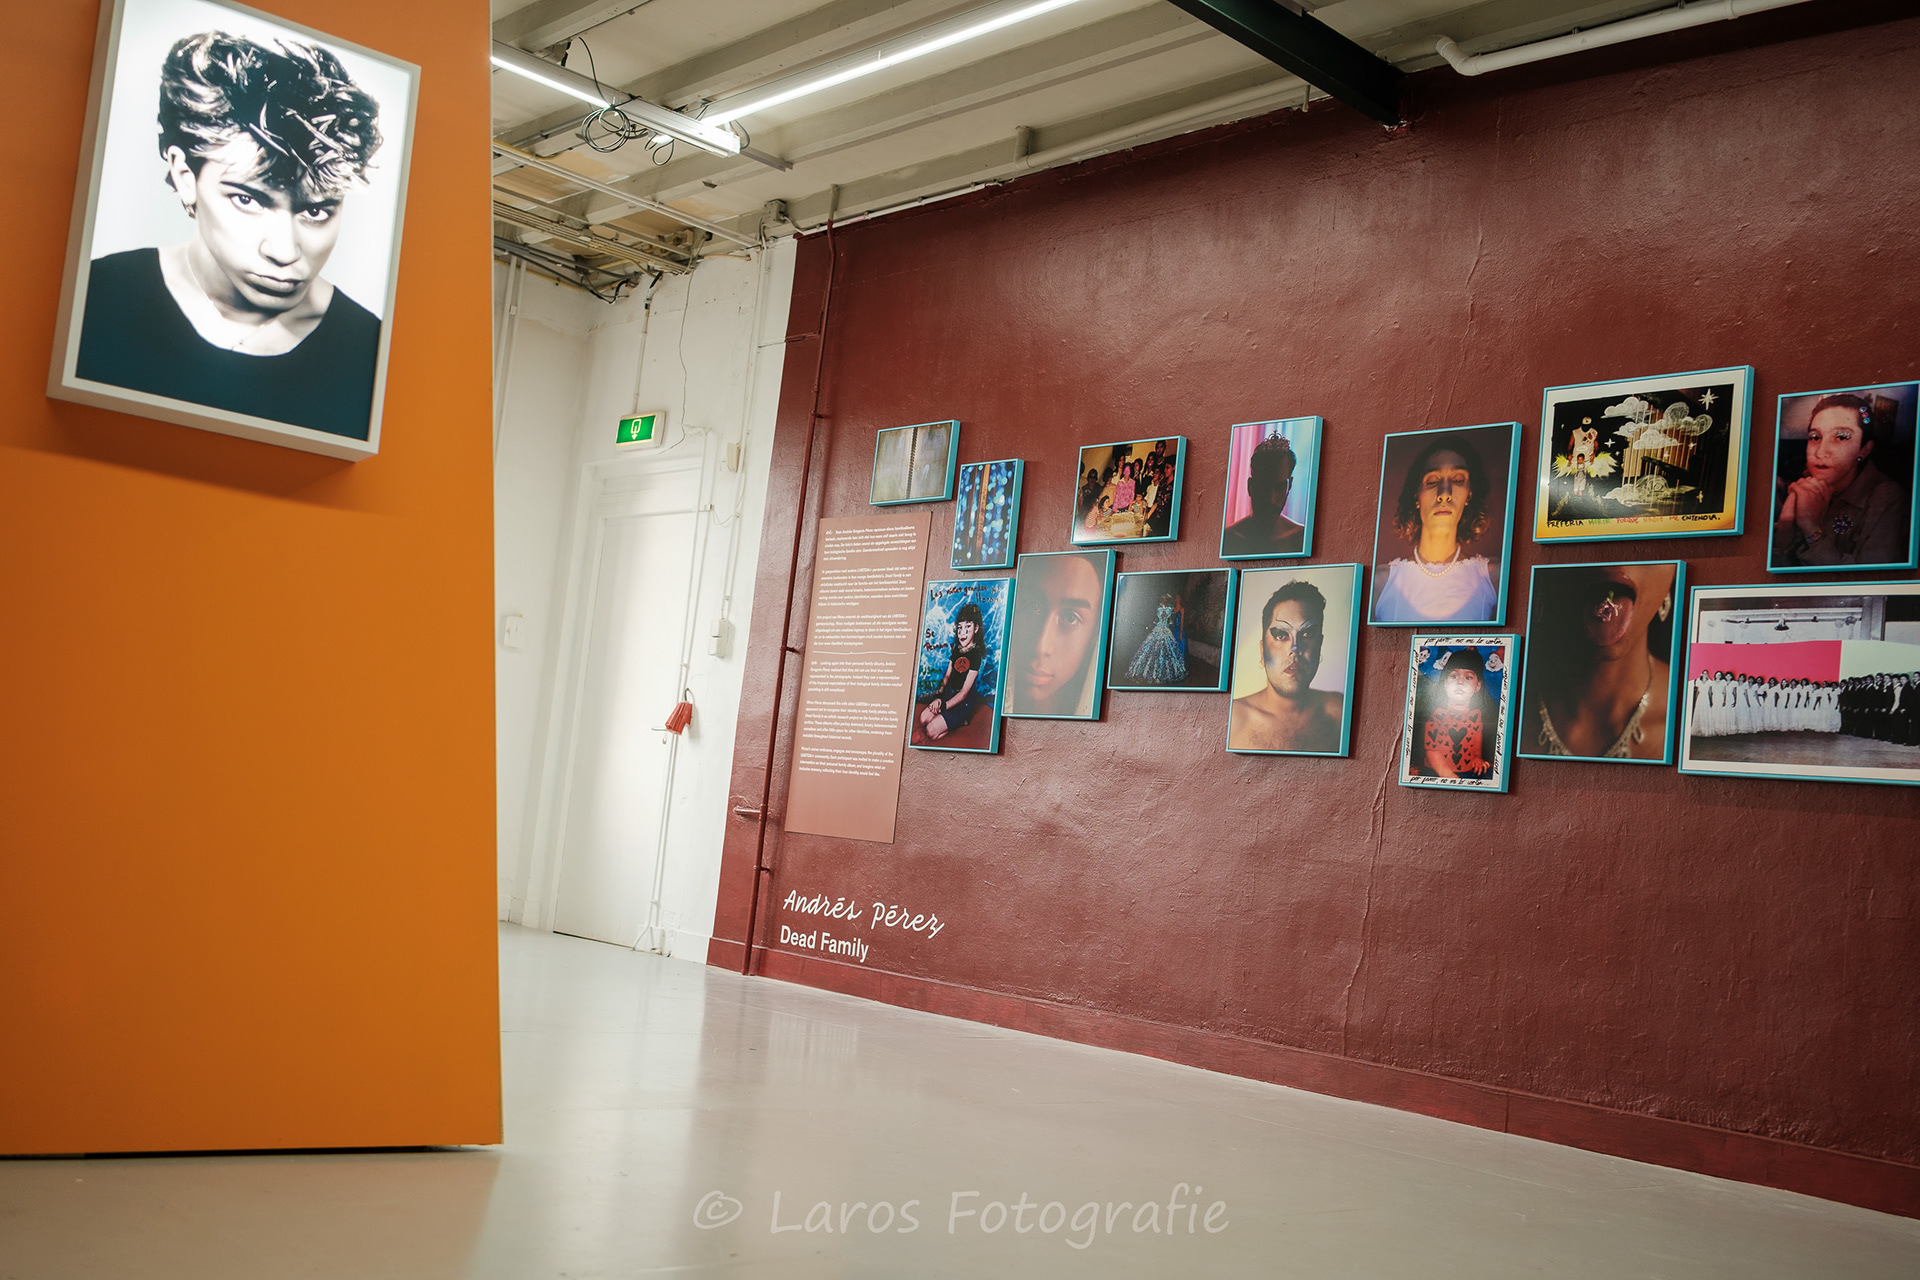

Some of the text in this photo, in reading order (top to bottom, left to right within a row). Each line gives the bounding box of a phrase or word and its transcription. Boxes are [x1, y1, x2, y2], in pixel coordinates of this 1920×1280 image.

[782, 889, 945, 939] Andrés Pérez
[780, 924, 869, 963] Dead Family
